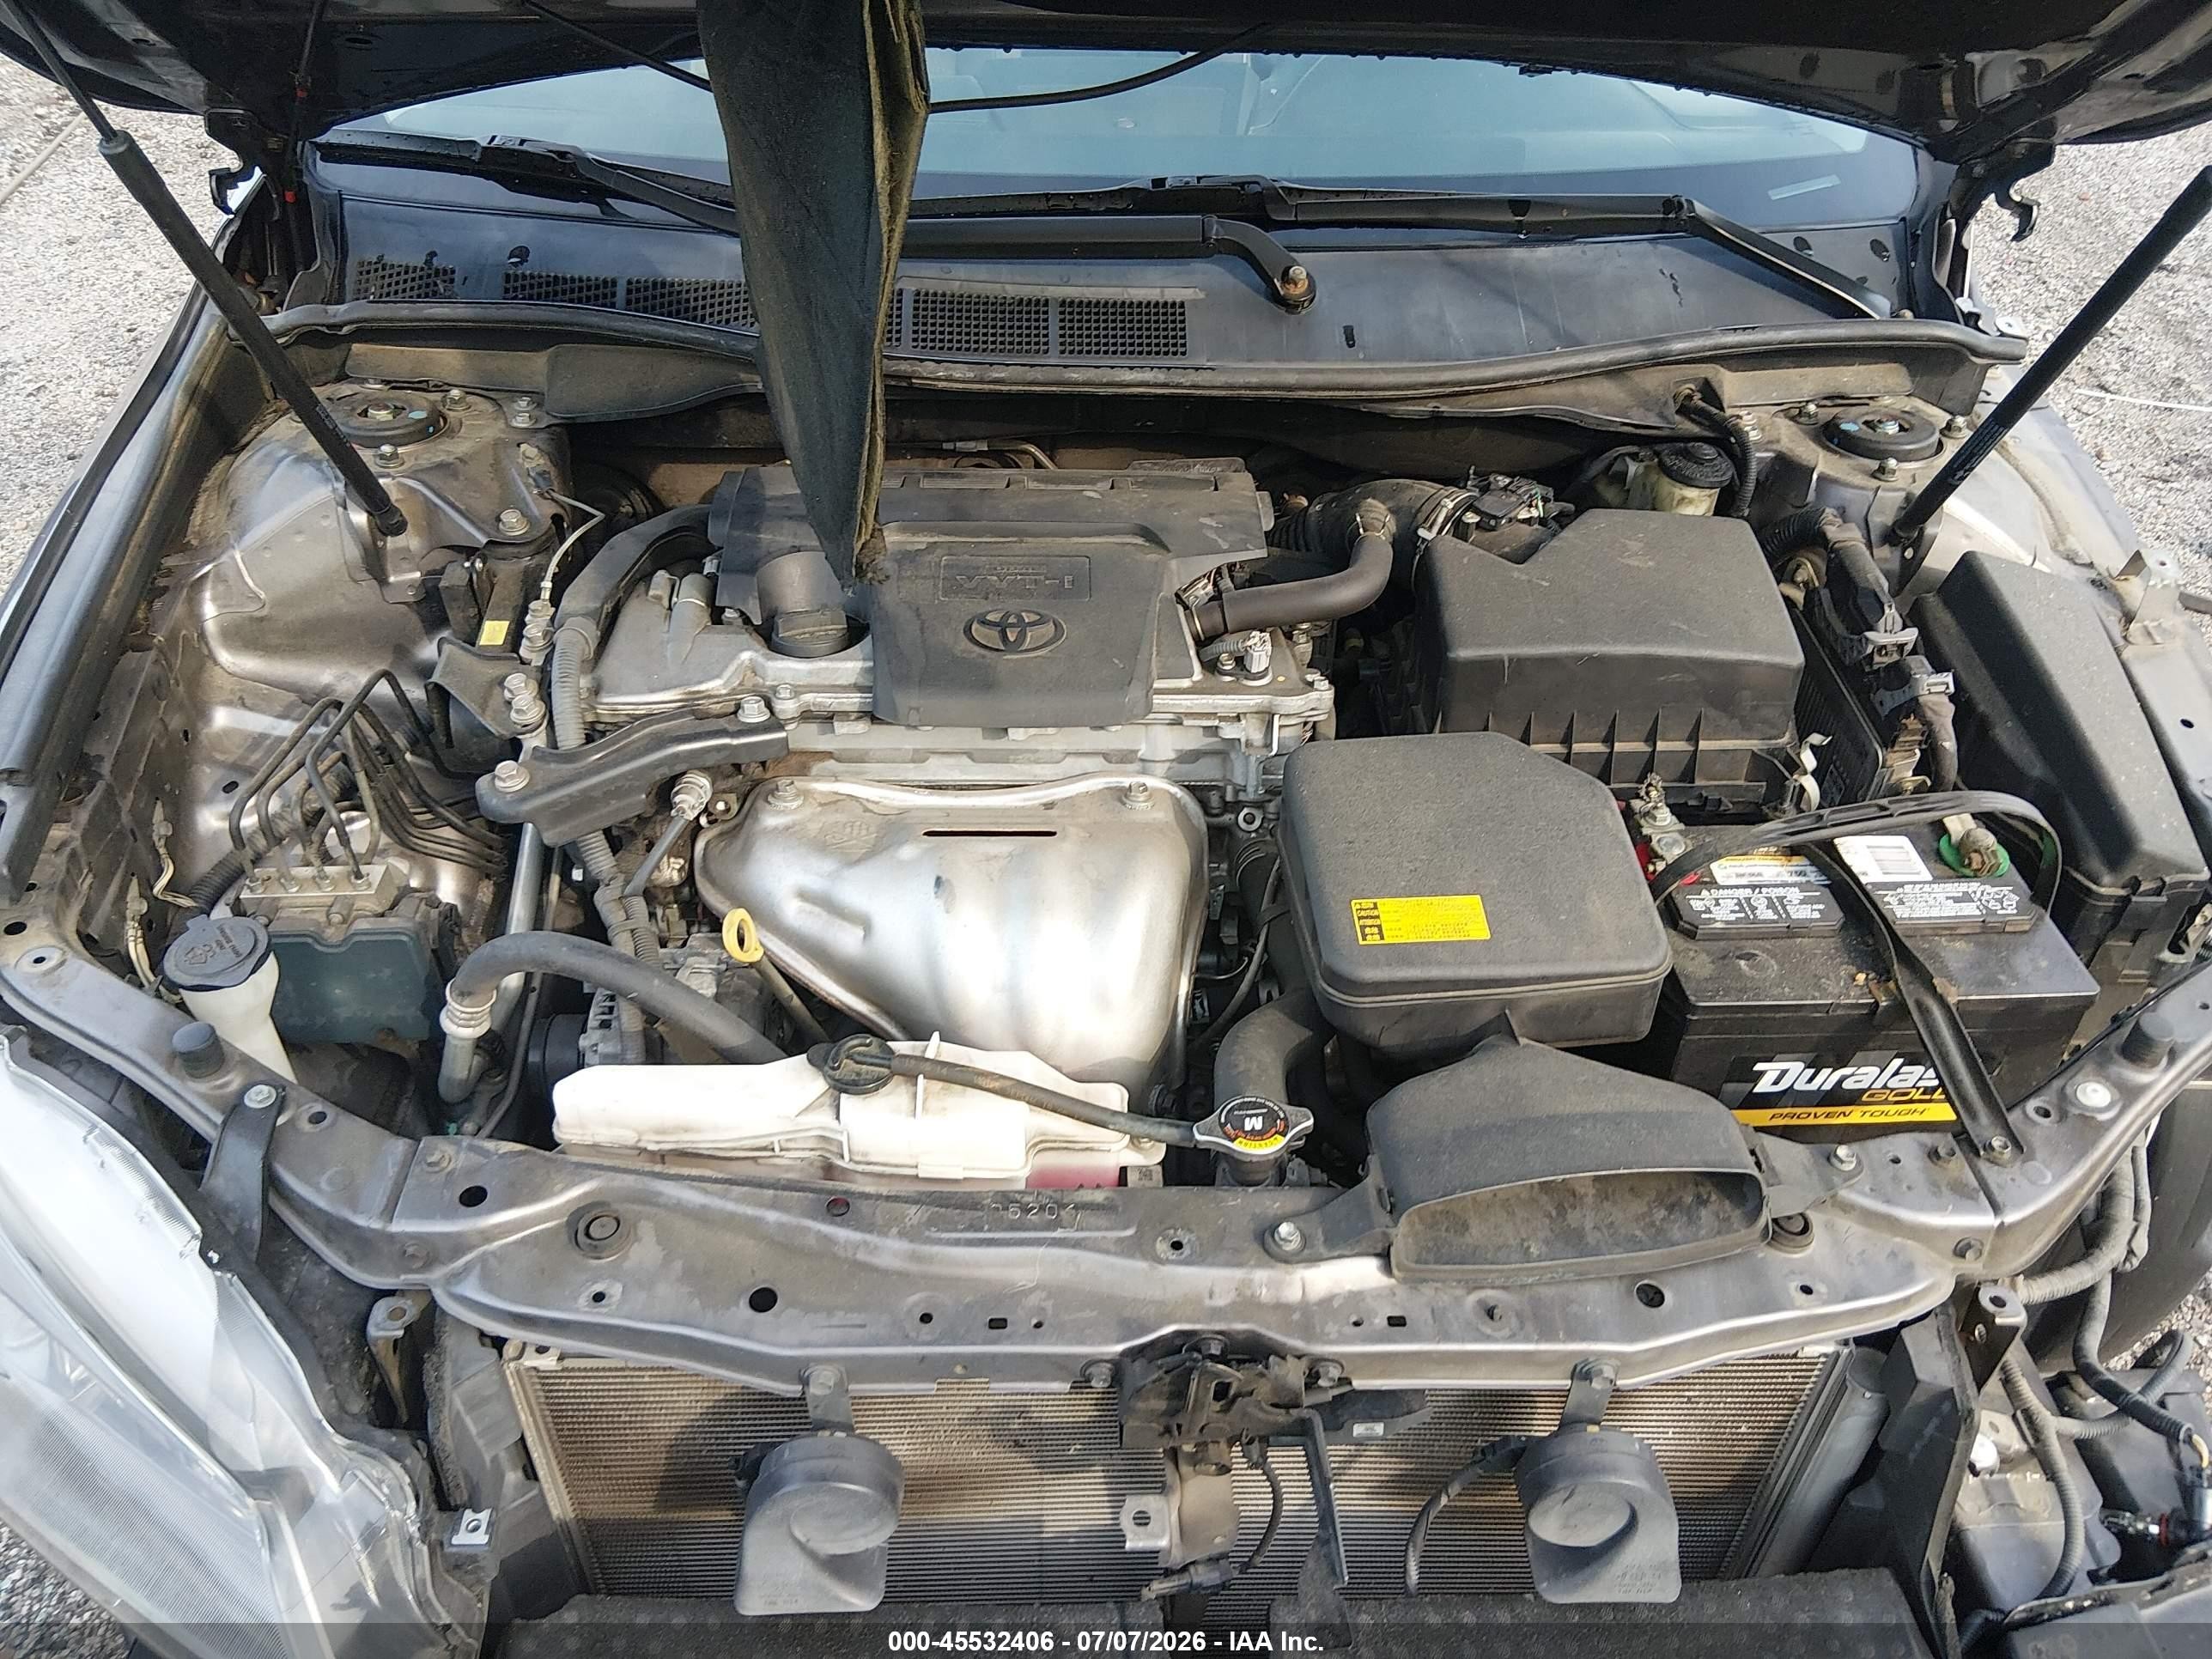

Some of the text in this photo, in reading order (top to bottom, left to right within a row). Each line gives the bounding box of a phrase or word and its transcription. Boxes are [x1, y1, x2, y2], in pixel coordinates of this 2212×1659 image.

[1752, 1057, 1940, 1093] Duralas
[1769, 1107, 1925, 1121] PROVEN TOUGH
